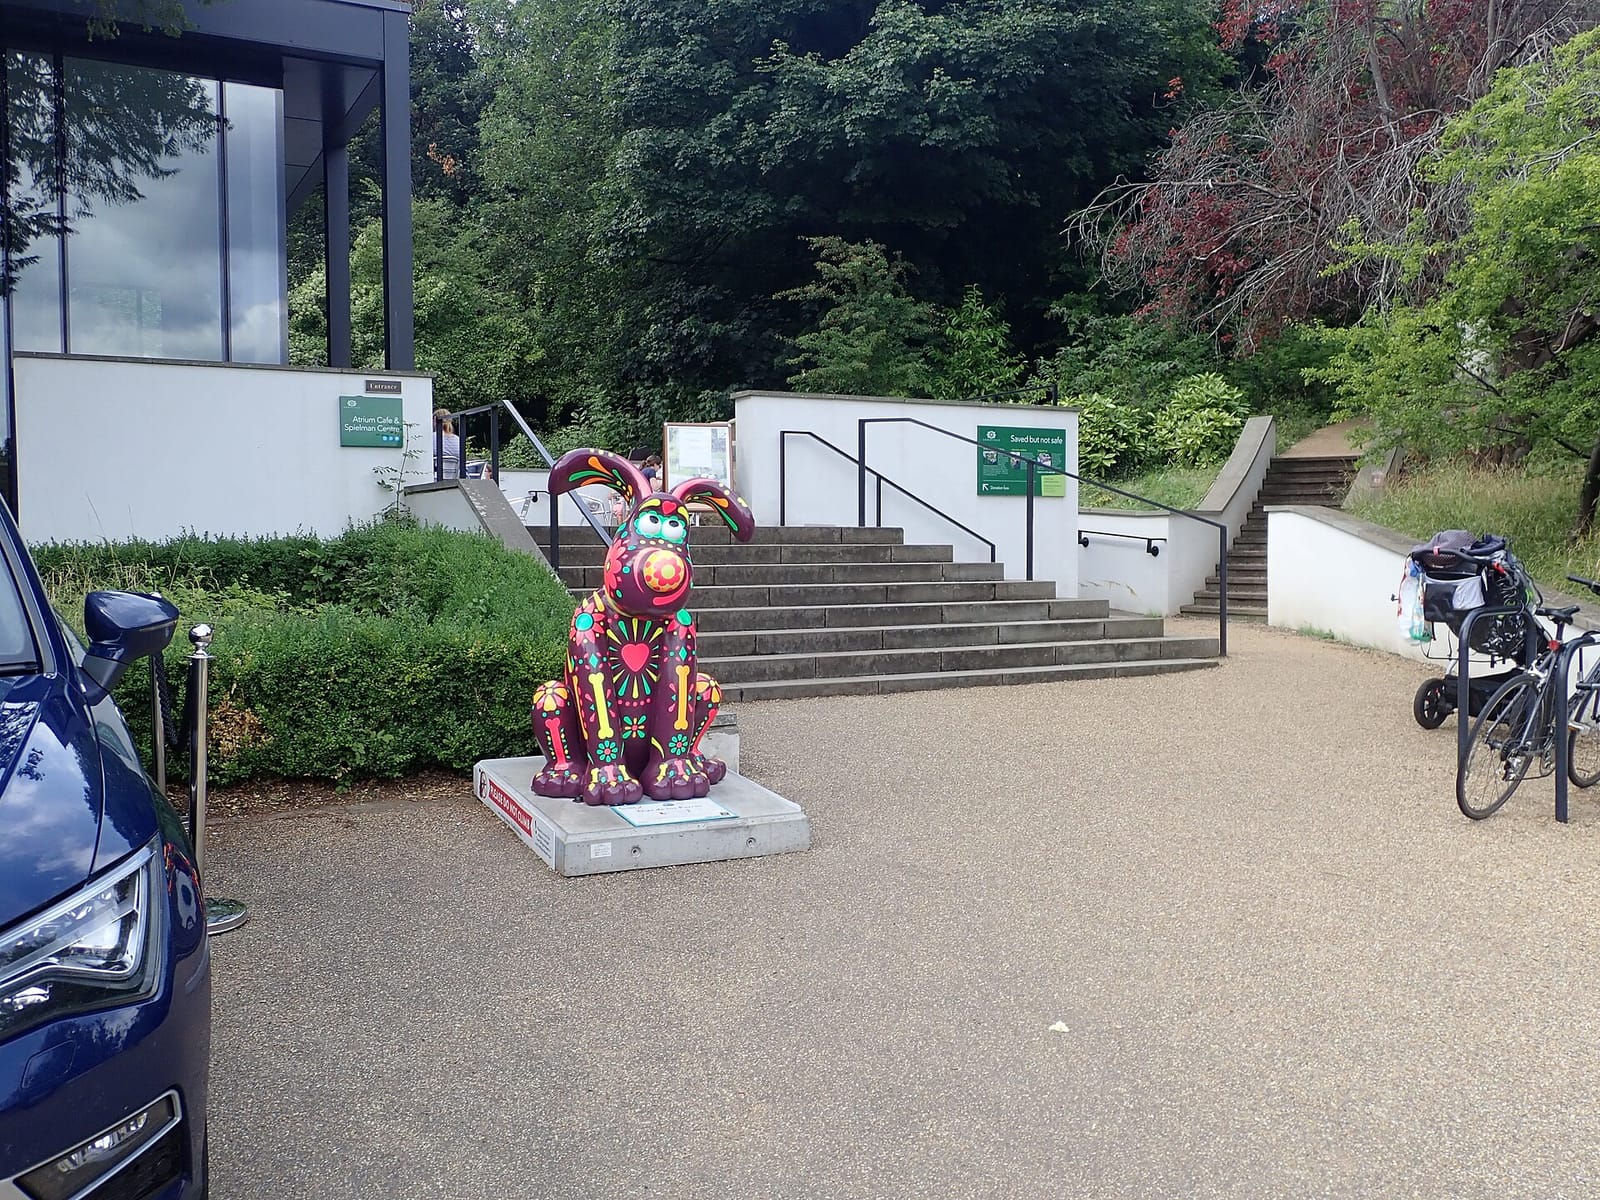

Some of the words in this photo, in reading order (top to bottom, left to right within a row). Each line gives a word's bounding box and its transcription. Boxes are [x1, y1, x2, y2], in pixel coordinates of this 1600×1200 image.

[352, 415, 376, 423] Atrium
[393, 416, 400, 424] &
[344, 423, 376, 433] Spielman
[376, 424, 400, 433] Centre
[1010, 434, 1029, 444] Saved
[1029, 435, 1040, 444] but
[1040, 436, 1051, 444] not
[1051, 436, 1063, 445] safe
[490, 784, 503, 805] PLEASE
[517, 810, 531, 831] CLIMB
